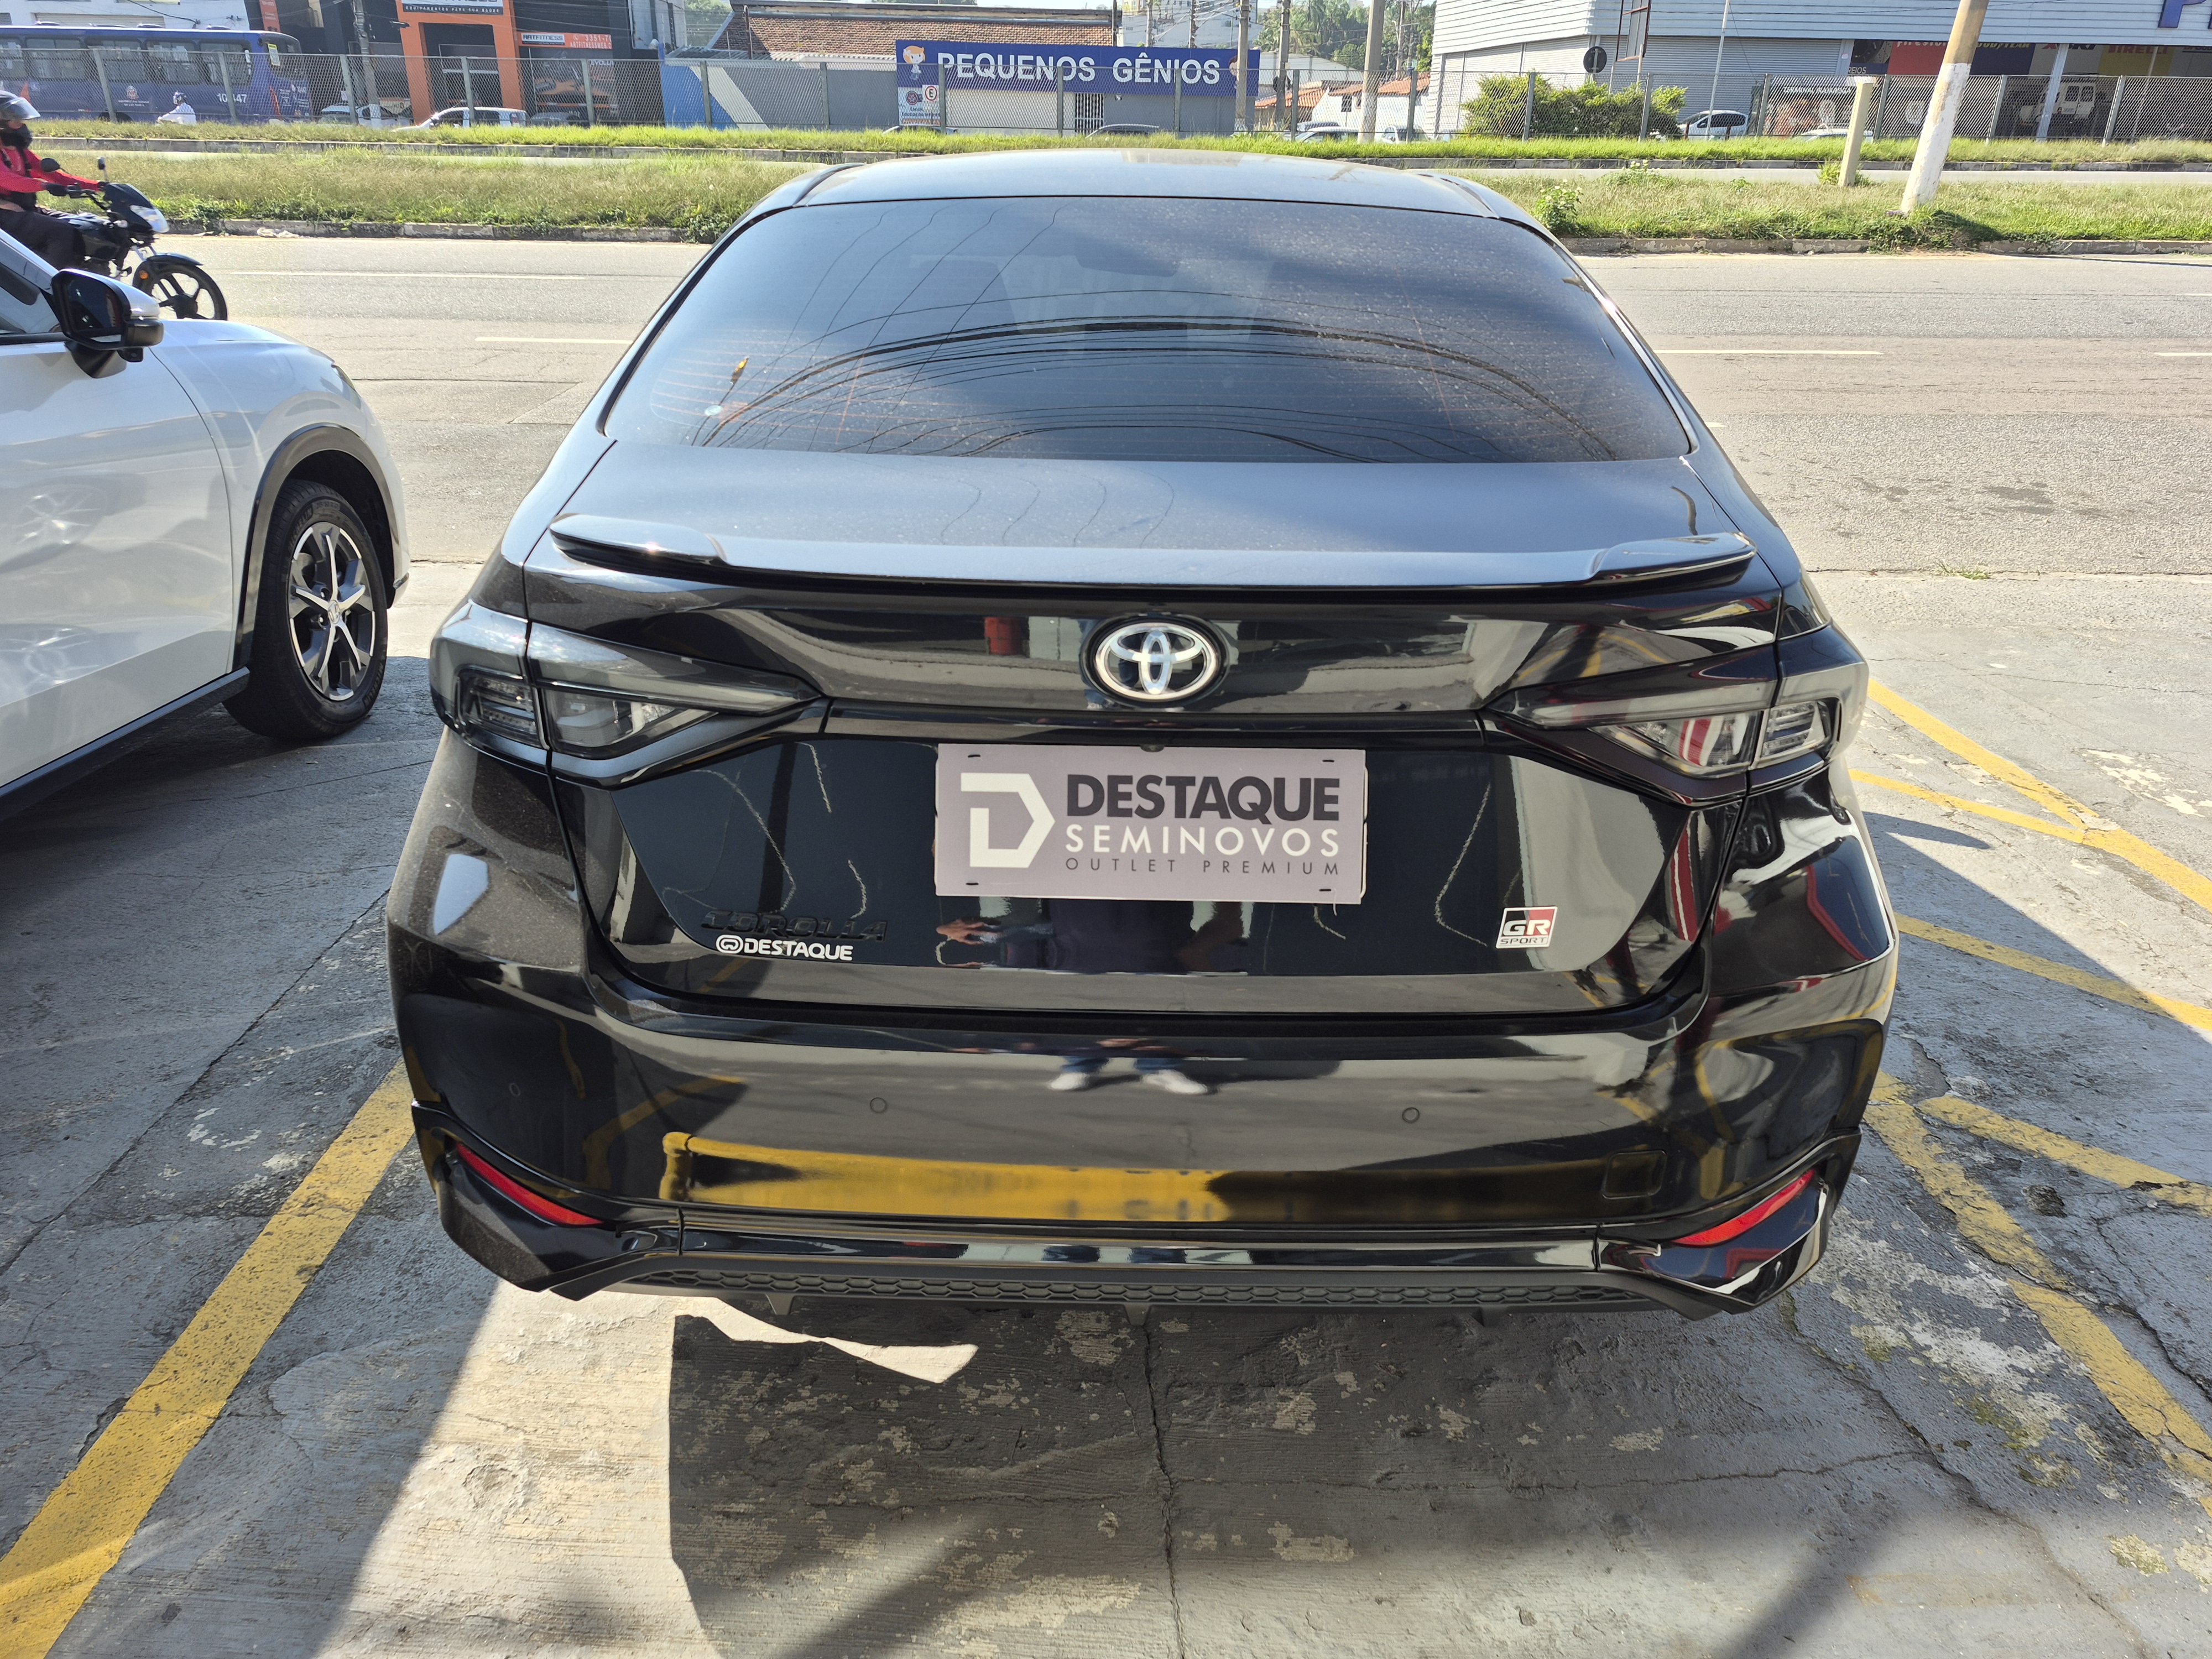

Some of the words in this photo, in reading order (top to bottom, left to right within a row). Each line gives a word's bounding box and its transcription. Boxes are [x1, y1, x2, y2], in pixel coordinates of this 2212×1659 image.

[938, 53, 1095, 82] PEQUENOS
[1113, 52, 1220, 84] GÊNIOS
[929, 88, 933, 97] E
[1066, 774, 1340, 825] DESTAQUE
[1065, 823, 1339, 857] SEMINOVOS
[1066, 857, 1176, 873] OUTLET
[1203, 860, 1339, 876] PREMIUM
[701, 910, 888, 941] COROLLA
[1503, 919, 1551, 936] GR
